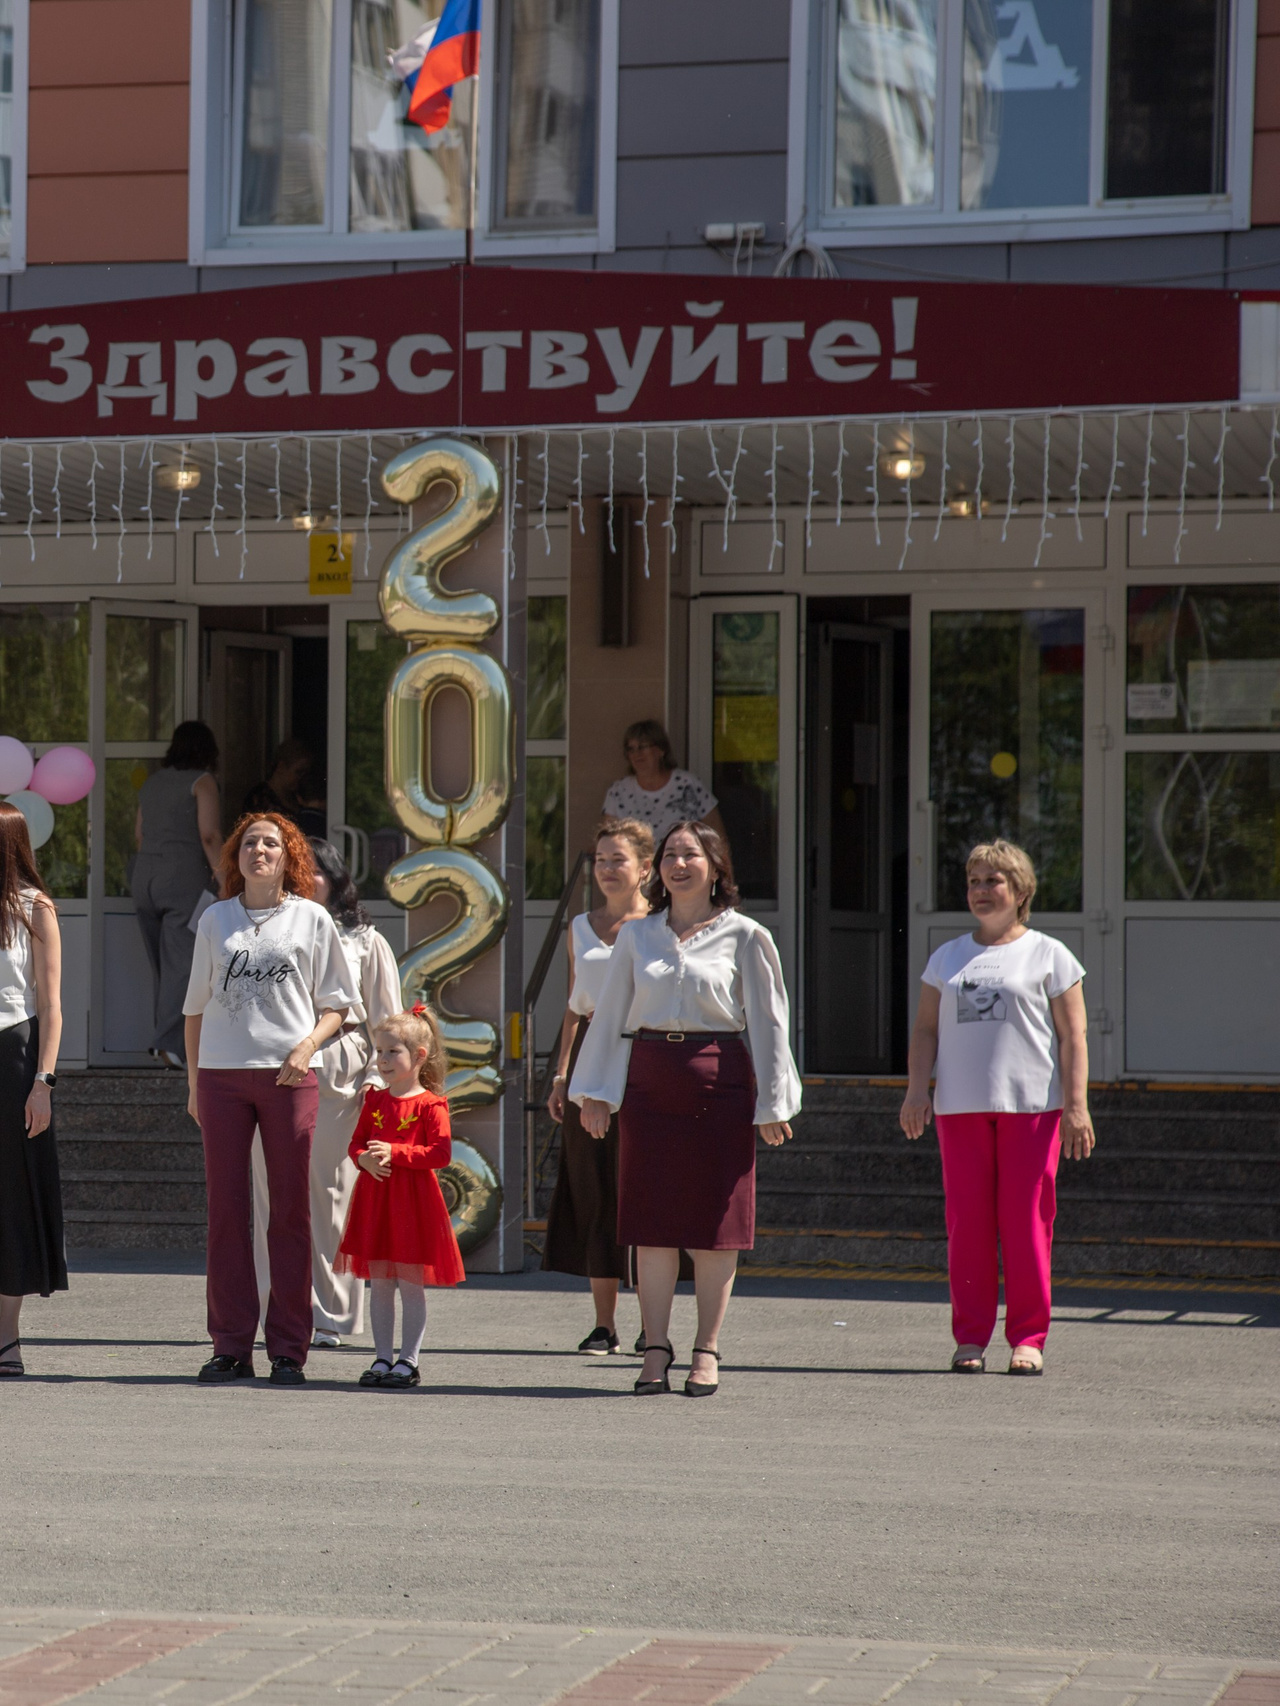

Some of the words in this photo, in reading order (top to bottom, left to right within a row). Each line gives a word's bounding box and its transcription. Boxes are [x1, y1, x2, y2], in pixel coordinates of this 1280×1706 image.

[26, 296, 919, 421] Здравствуйте!
[327, 543, 338, 563] 2
[317, 572, 349, 581] ВХОД
[223, 949, 296, 992] Paris
